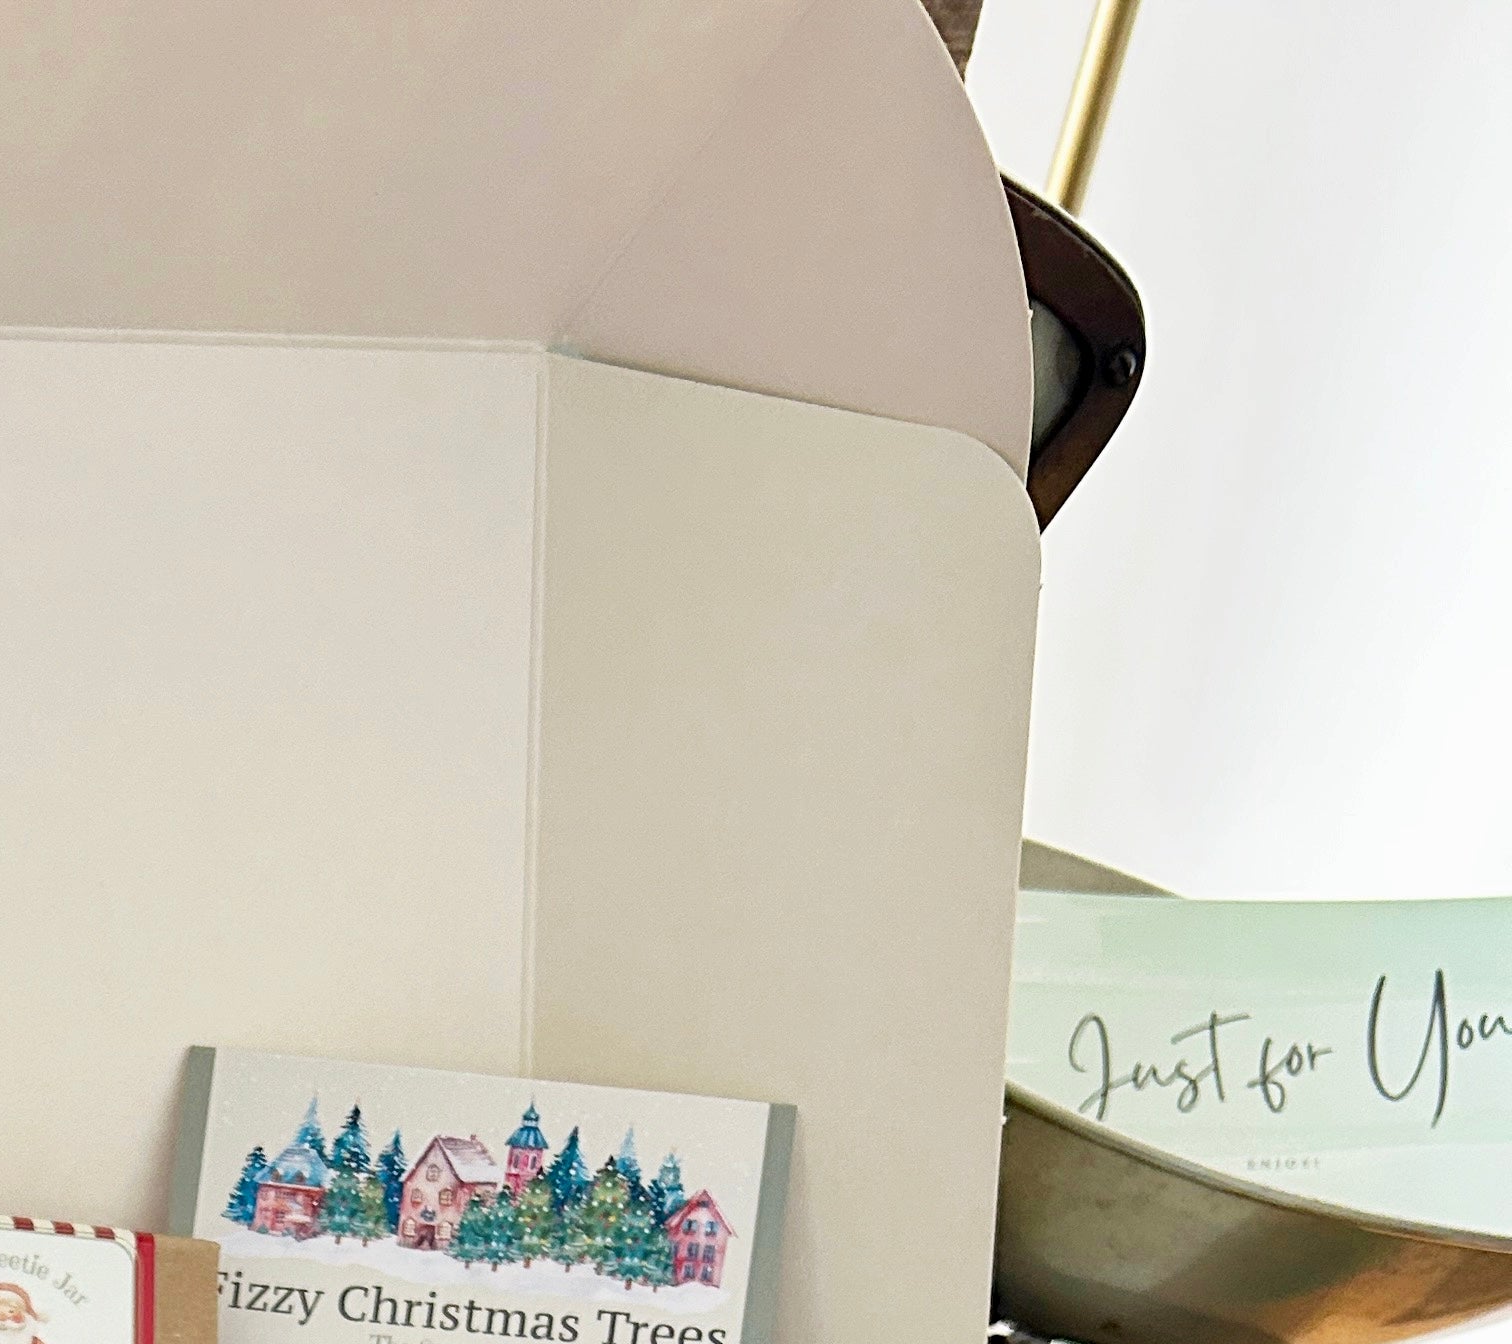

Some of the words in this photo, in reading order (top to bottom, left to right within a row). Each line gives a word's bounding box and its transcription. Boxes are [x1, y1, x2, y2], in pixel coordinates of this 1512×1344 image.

[1068, 1012, 1250, 1122] Just
[1246, 1036, 1333, 1114] for
[52, 1271, 88, 1307] Jar
[339, 1286, 579, 1344] Christmas
